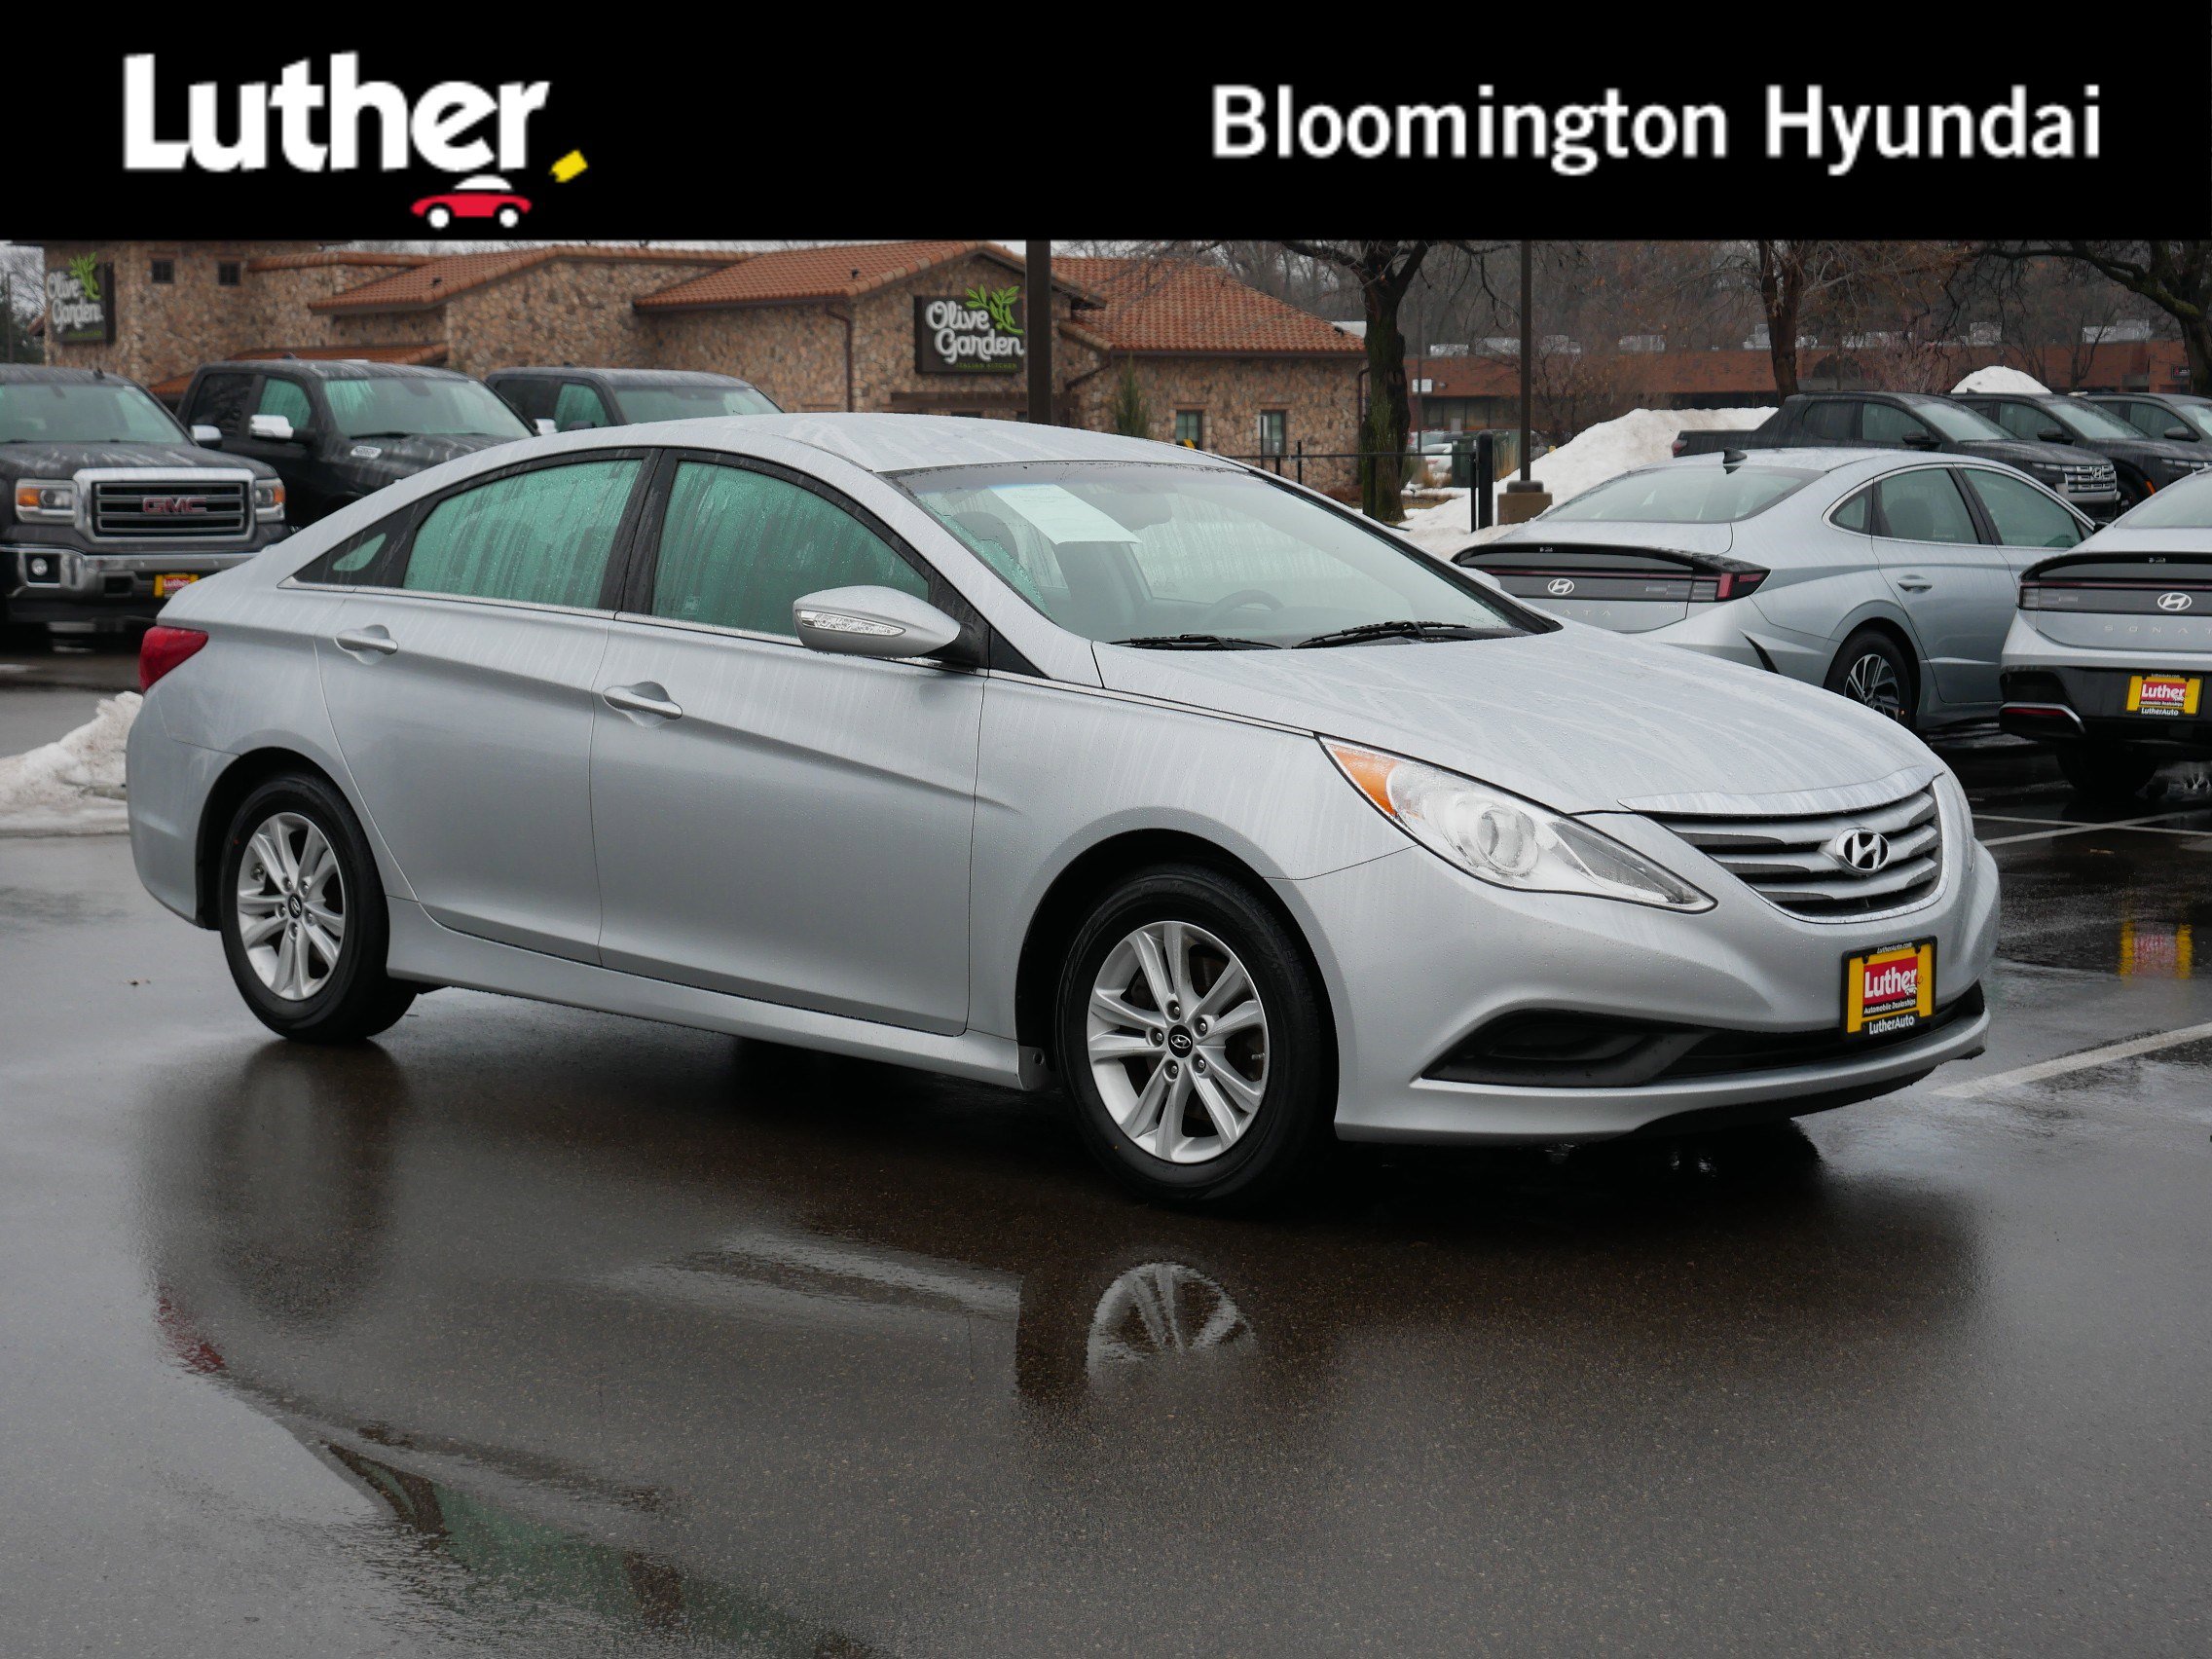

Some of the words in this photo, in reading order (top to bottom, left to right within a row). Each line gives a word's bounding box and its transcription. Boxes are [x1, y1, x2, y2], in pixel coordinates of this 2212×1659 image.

[47, 271, 84, 300] Olive
[52, 296, 104, 333] Garden
[925, 300, 991, 331] Olive
[935, 327, 1025, 364] Garden
[142, 497, 207, 516] GMC
[2141, 683, 2185, 699] Luther
[2141, 707, 2179, 717] LutherAuto
[1864, 966, 1917, 999] Luther
[1863, 1003, 1892, 1014] Automobile
[1892, 998, 1916, 1012] Dealerships
[1868, 1014, 1915, 1035] LutherAuto
